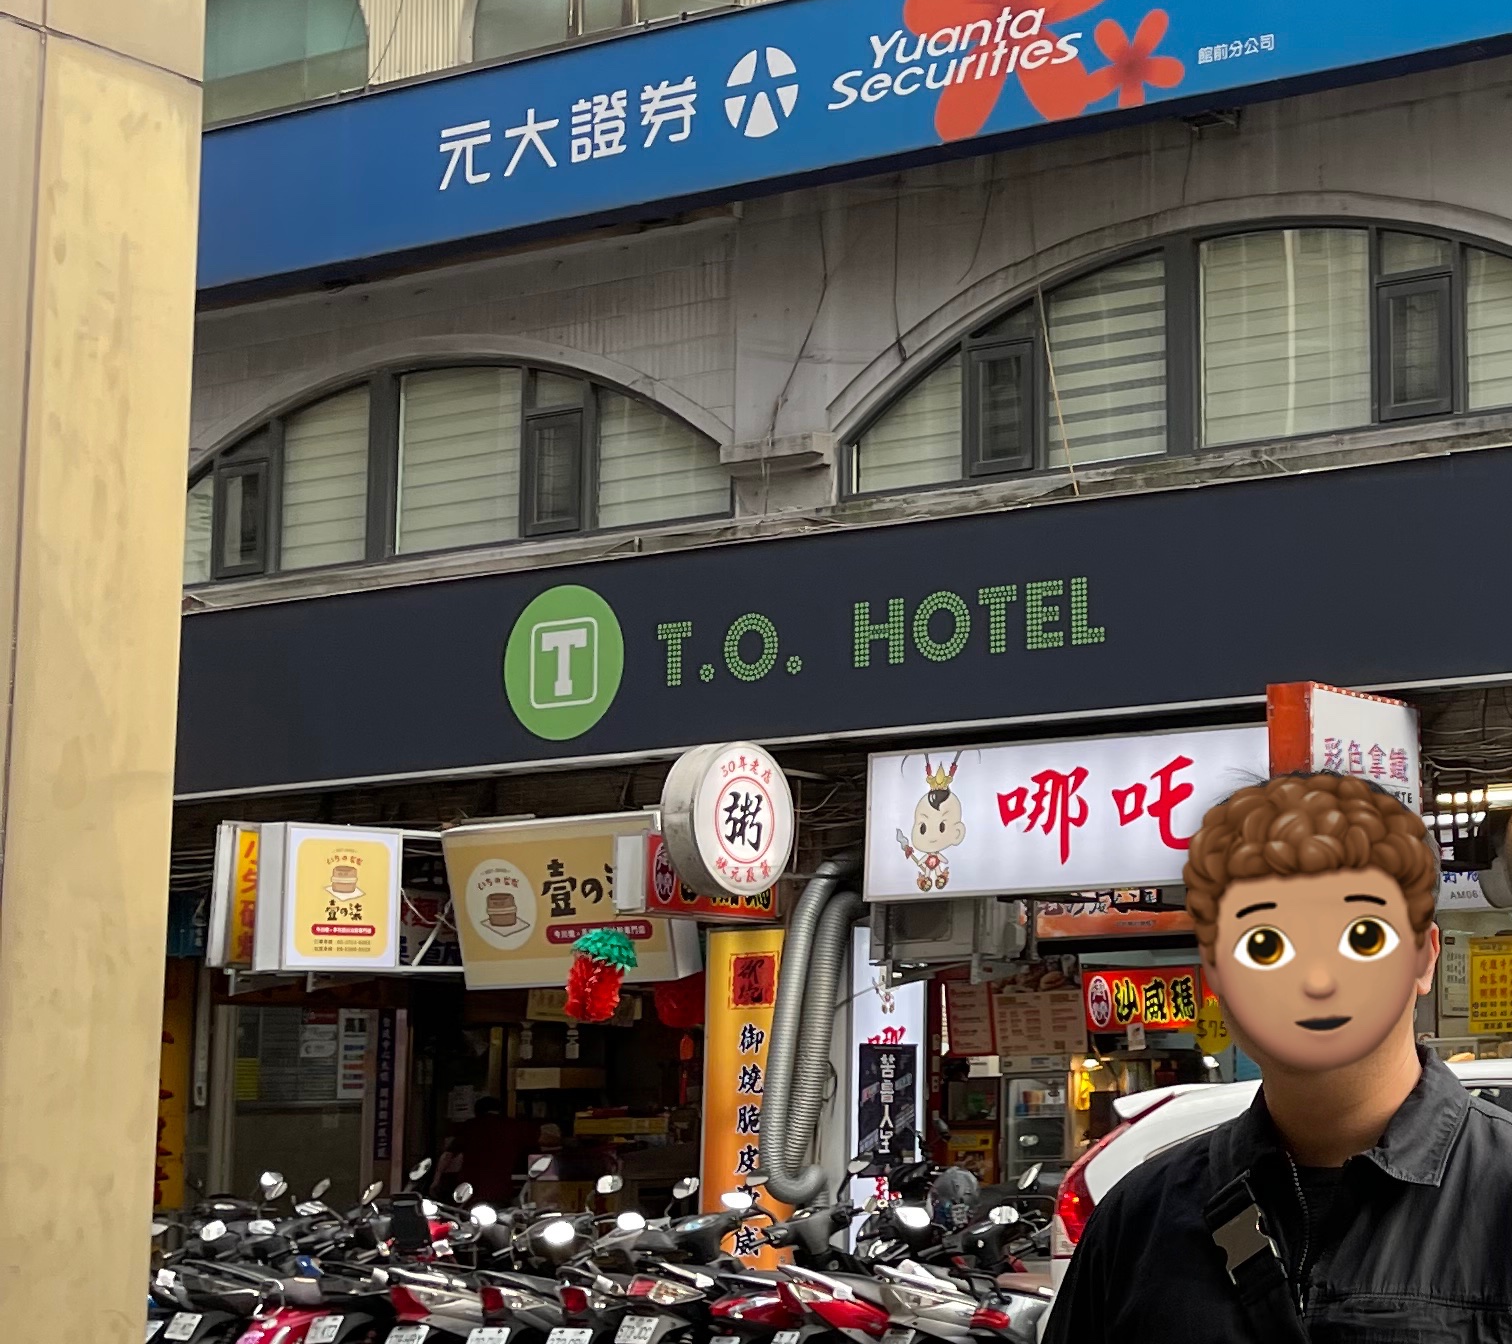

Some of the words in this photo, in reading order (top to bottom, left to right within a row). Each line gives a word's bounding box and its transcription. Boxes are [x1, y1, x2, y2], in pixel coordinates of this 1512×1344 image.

[870, 6, 1046, 67] Yuanta
[1198, 33, 1275, 64] 館前分公司
[827, 32, 1083, 111] Securities
[438, 75, 698, 192] 元大證券
[540, 627, 588, 696] T
[656, 612, 802, 687] T.O.
[853, 576, 1106, 668] HOTEL
[722, 791, 764, 853] 粥
[995, 755, 1195, 866] 哪吒
[541, 858, 614, 918] 壹の
[1113, 976, 1197, 1023] 沙威瑪
